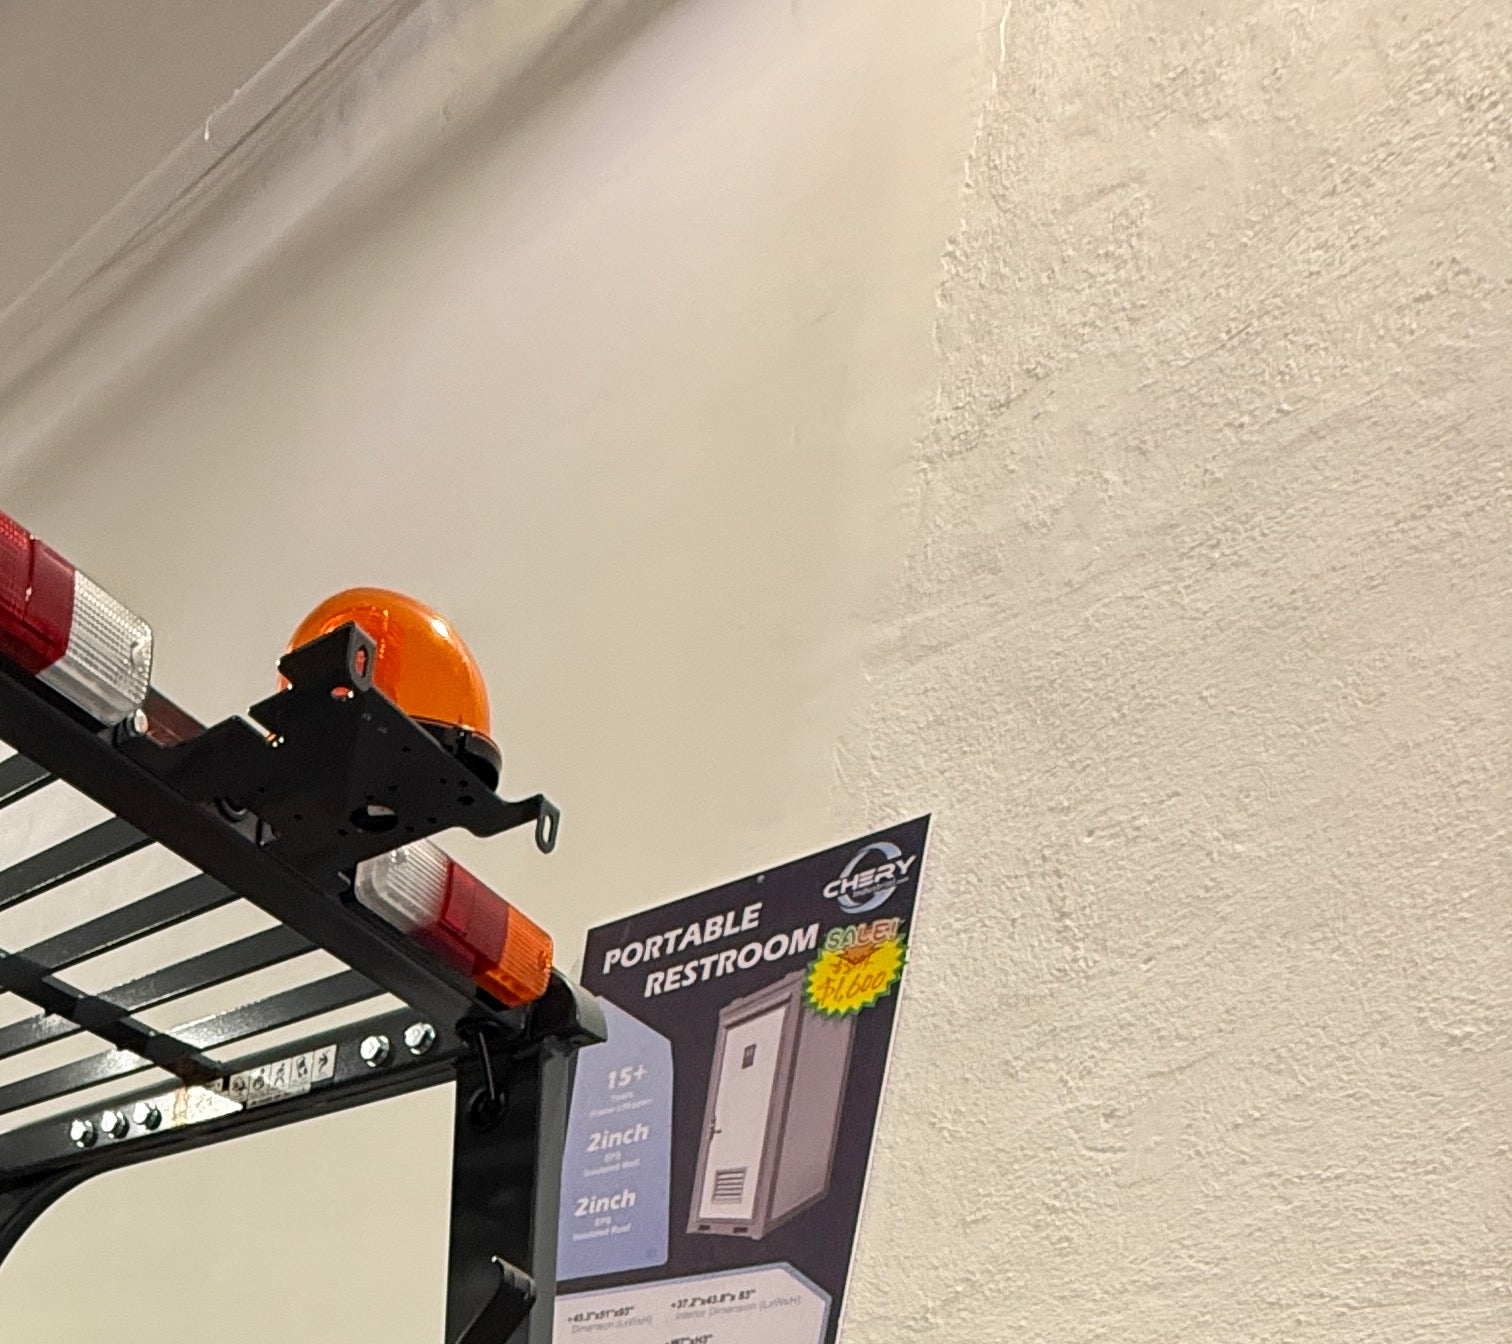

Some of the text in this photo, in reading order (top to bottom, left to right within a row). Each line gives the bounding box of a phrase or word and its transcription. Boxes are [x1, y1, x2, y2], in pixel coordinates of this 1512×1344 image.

[823, 855, 916, 898] CHERY
[603, 902, 763, 974] PORTABLE
[826, 917, 901, 950] SALE!
[644, 923, 819, 998] RESTROOM
[609, 1064, 648, 1089] 15+
[586, 1123, 649, 1152] 2inch
[574, 1188, 636, 1216] 2inch
